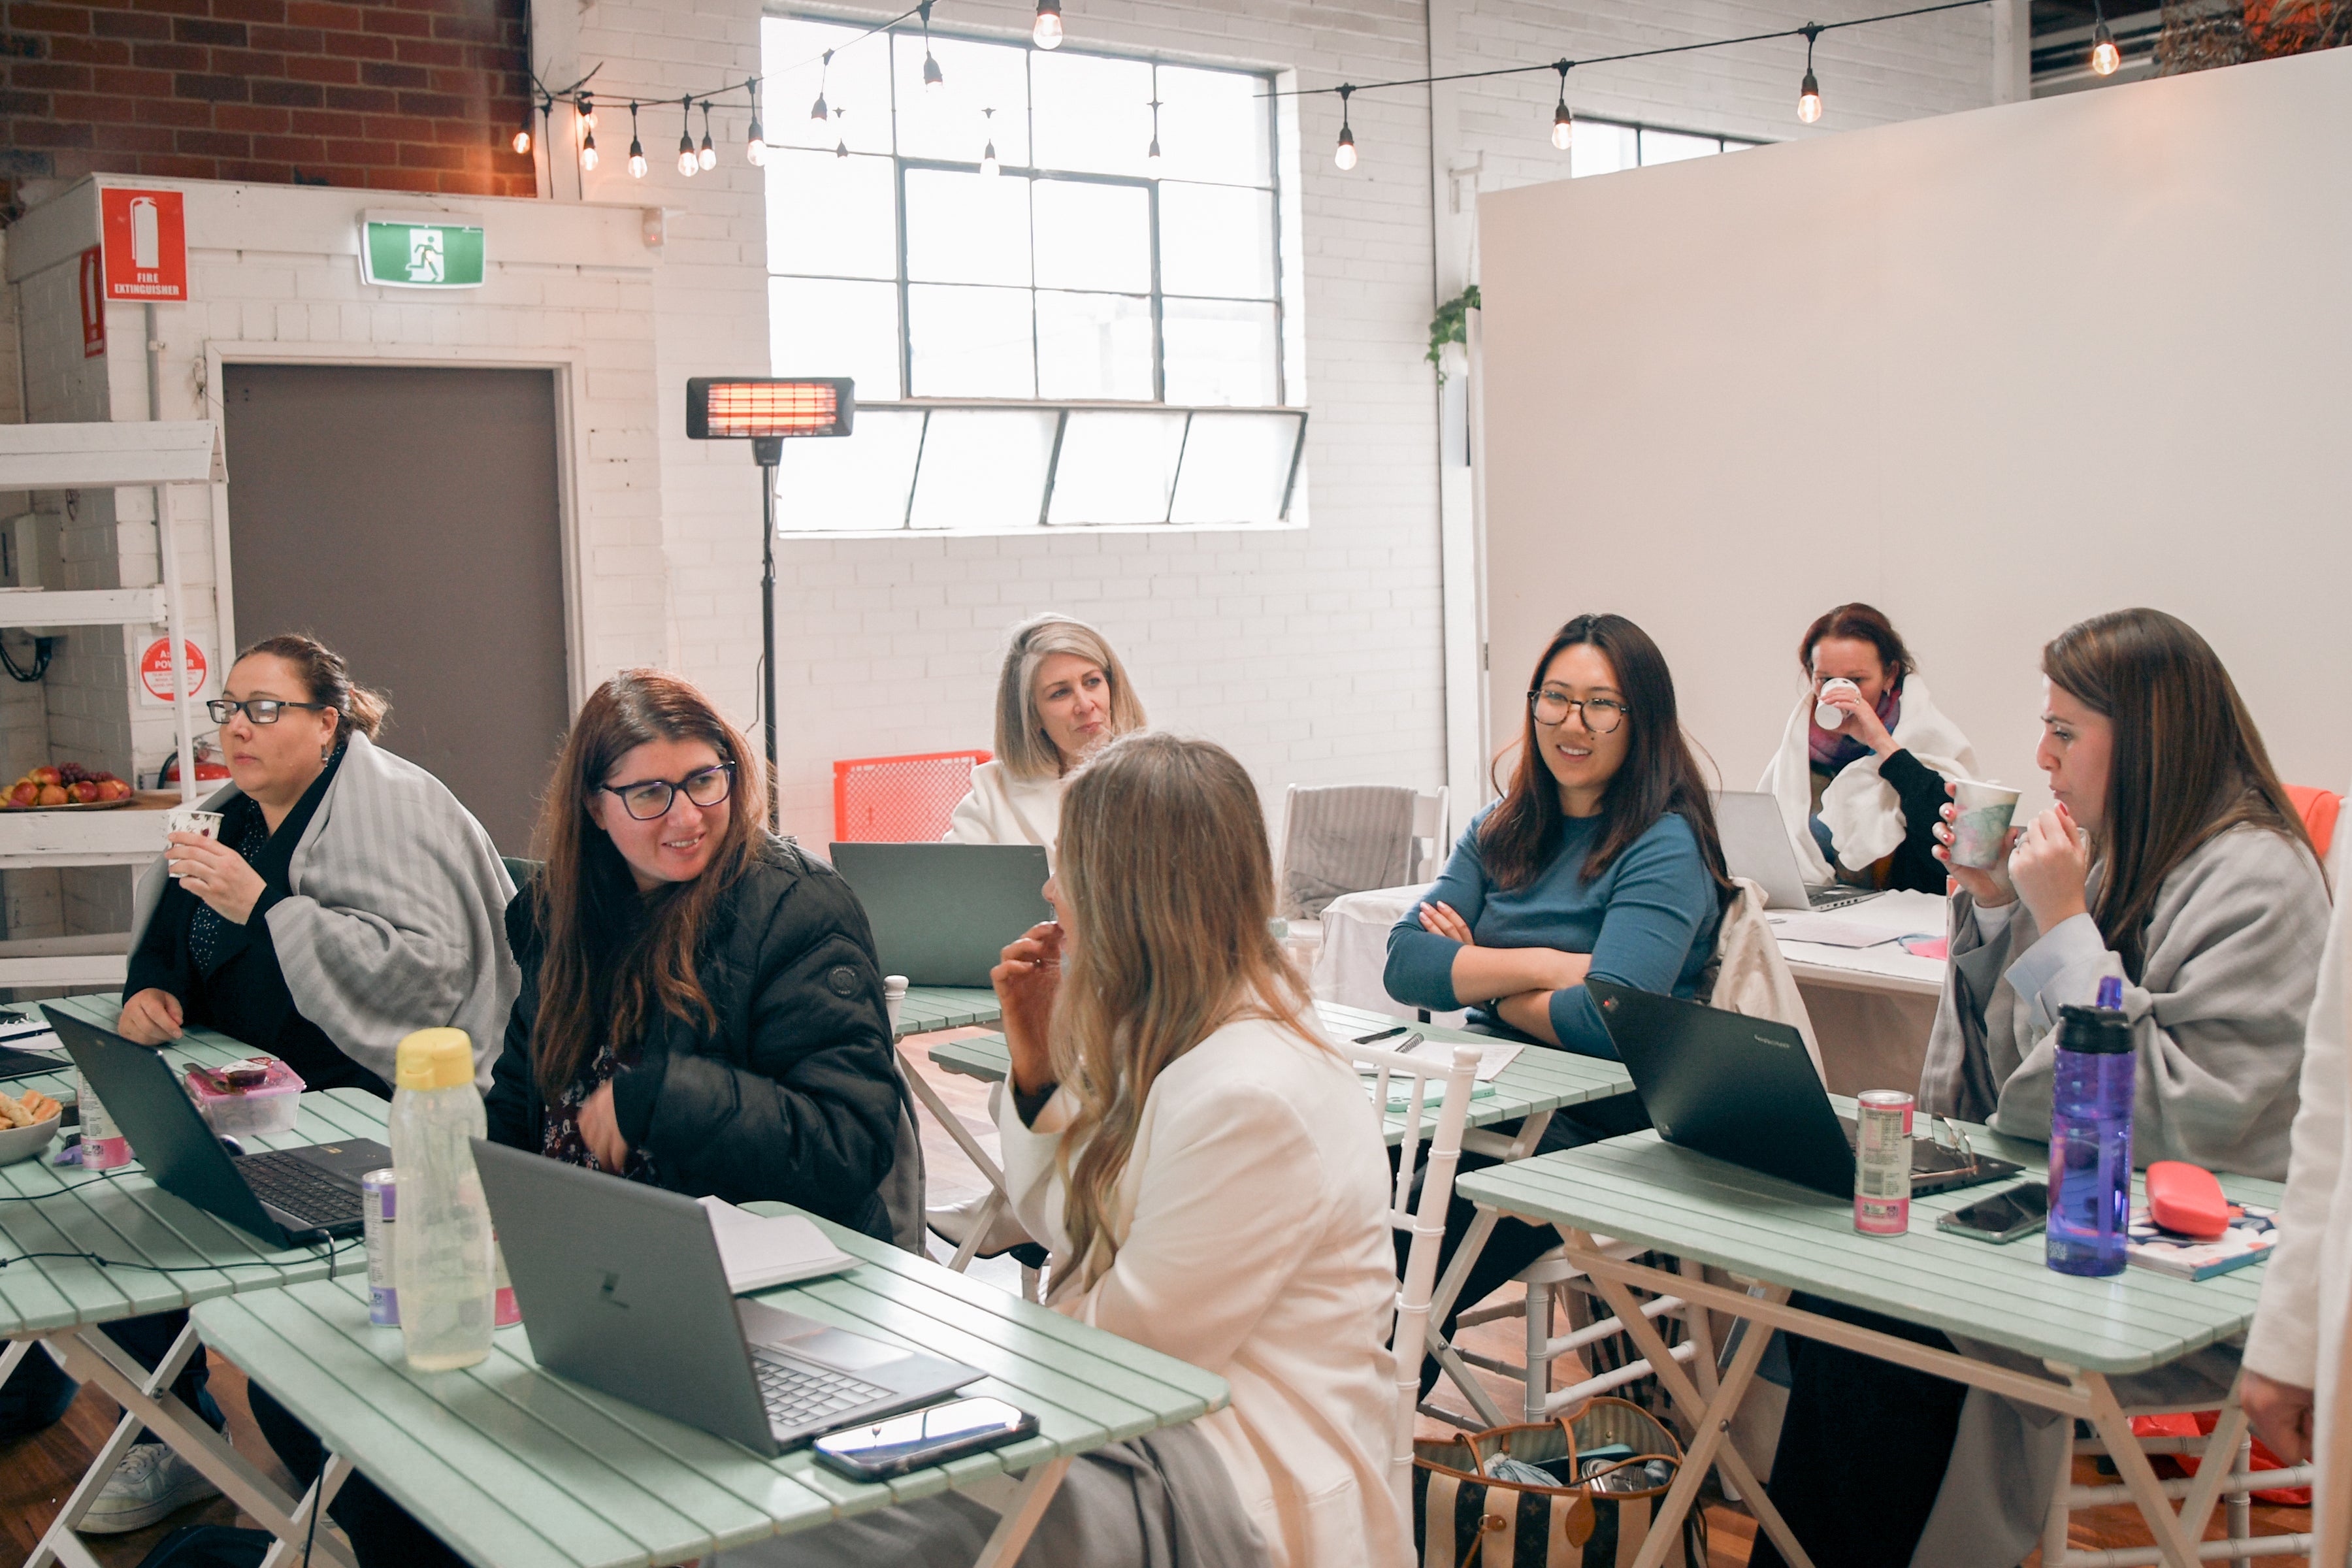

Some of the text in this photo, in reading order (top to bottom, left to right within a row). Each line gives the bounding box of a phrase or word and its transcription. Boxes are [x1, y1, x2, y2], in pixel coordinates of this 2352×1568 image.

[137, 272, 159, 283] FIRE
[114, 283, 180, 295] EXTINGUISHER
[155, 659, 194, 669] POR
